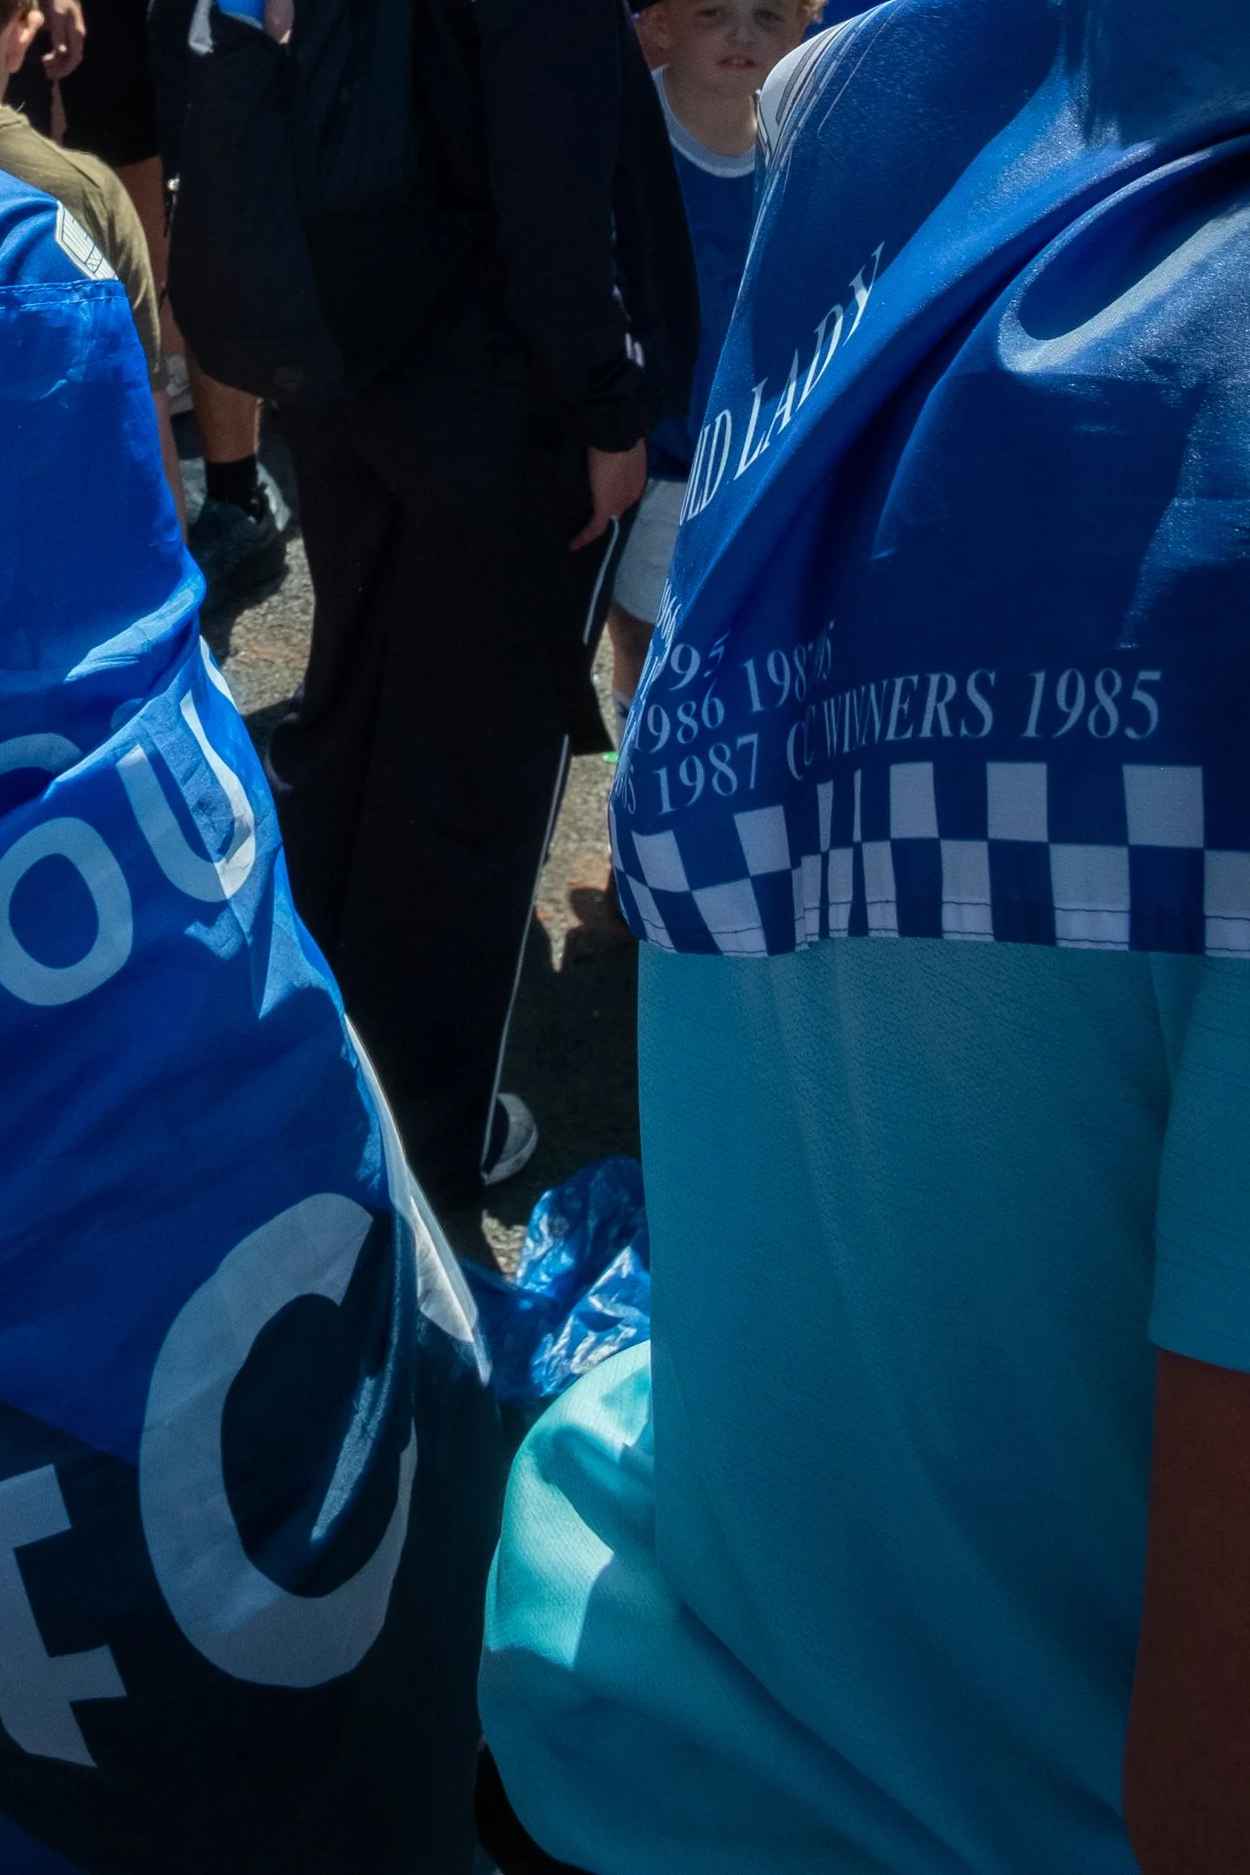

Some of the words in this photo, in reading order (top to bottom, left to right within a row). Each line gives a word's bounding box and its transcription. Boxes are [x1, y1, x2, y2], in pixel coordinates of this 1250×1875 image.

[733, 241, 886, 482] LADY
[652, 732, 759, 816] 1987
[1019, 667, 1163, 741] 1985
